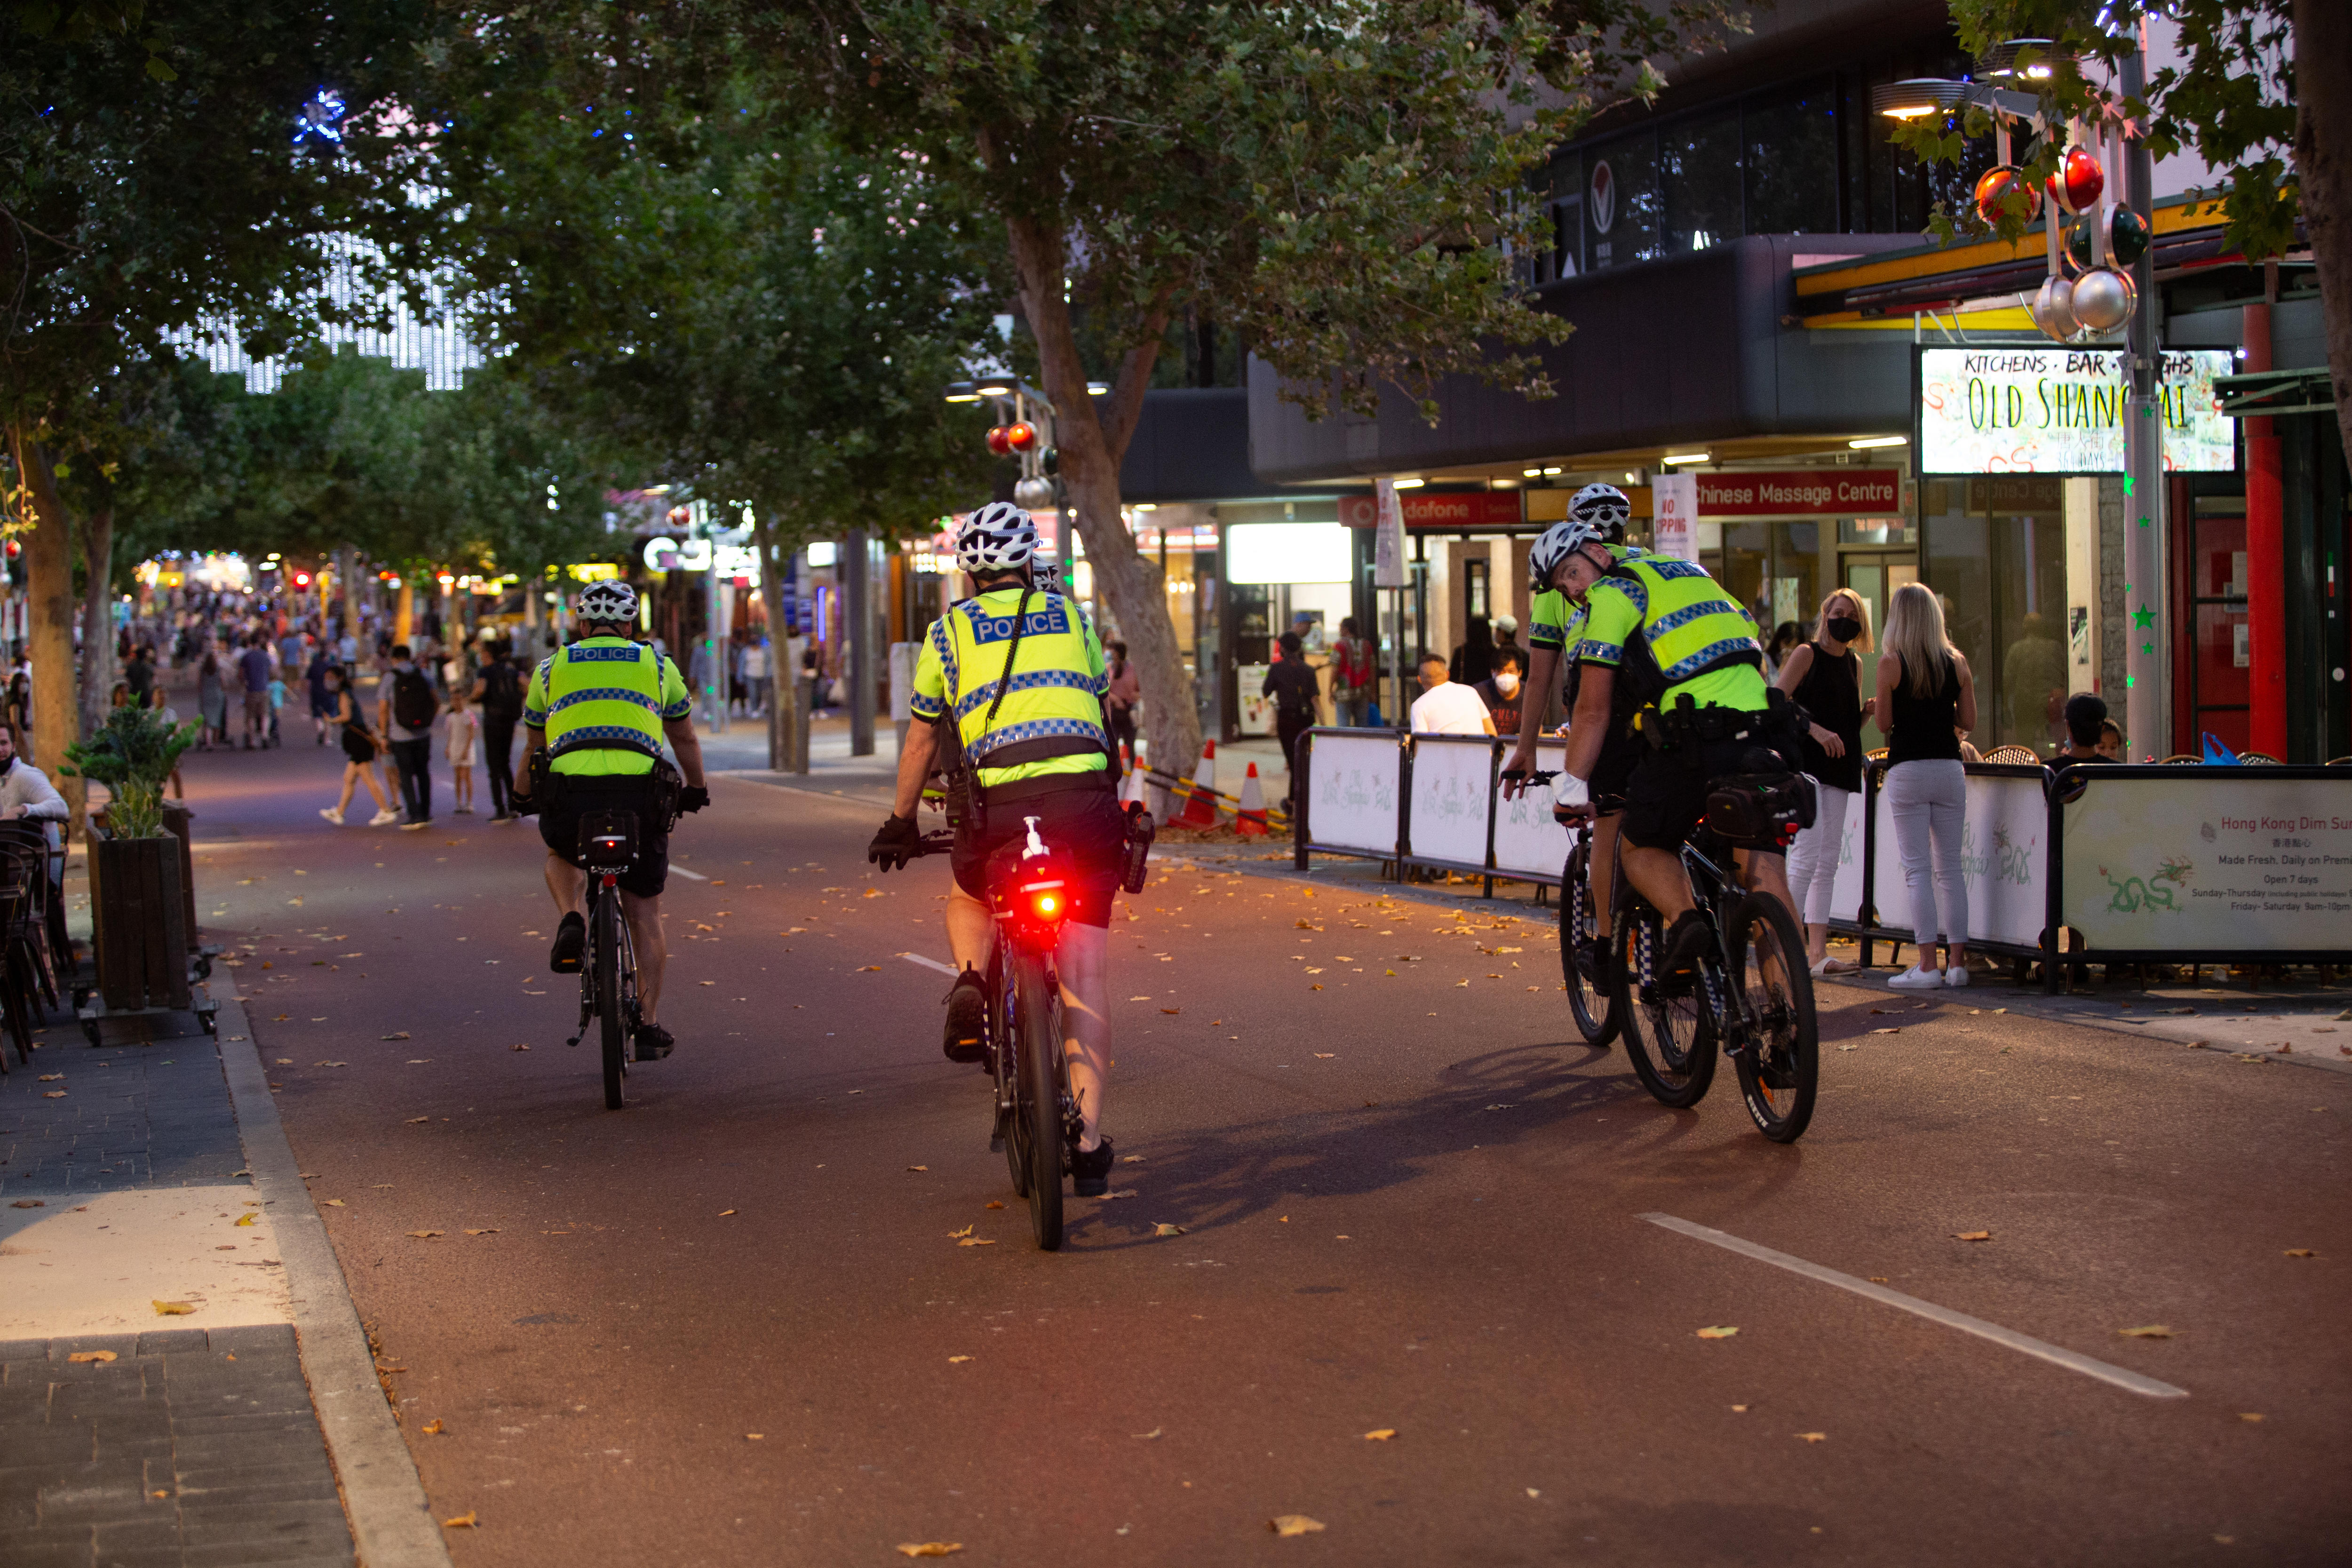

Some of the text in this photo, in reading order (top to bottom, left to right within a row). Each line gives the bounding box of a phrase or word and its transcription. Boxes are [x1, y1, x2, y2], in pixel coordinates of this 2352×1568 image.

[1965, 354, 2046, 373] KITCHENS
[2066, 354, 2106, 376] BAR
[1969, 378, 2185, 429] OLD SHANAI
[2079, 452, 2105, 472] DAYS
[1759, 483, 1832, 506] Massage
[1838, 482, 1893, 501] Centre
[1405, 501, 1469, 517] dafone
[1657, 562, 1711, 577] POLIC
[572, 648, 636, 660] POLICE
[2222, 817, 2256, 832] Hong
[2261, 817, 2295, 832] Kong
[2300, 817, 2326, 829] Dim
[2219, 855, 2245, 864] Made
[2281, 855, 2305, 867] Daily
[2264, 875, 2287, 885] Open
[2297, 875, 2318, 885] days
[2263, 902, 2300, 912] Saturday
